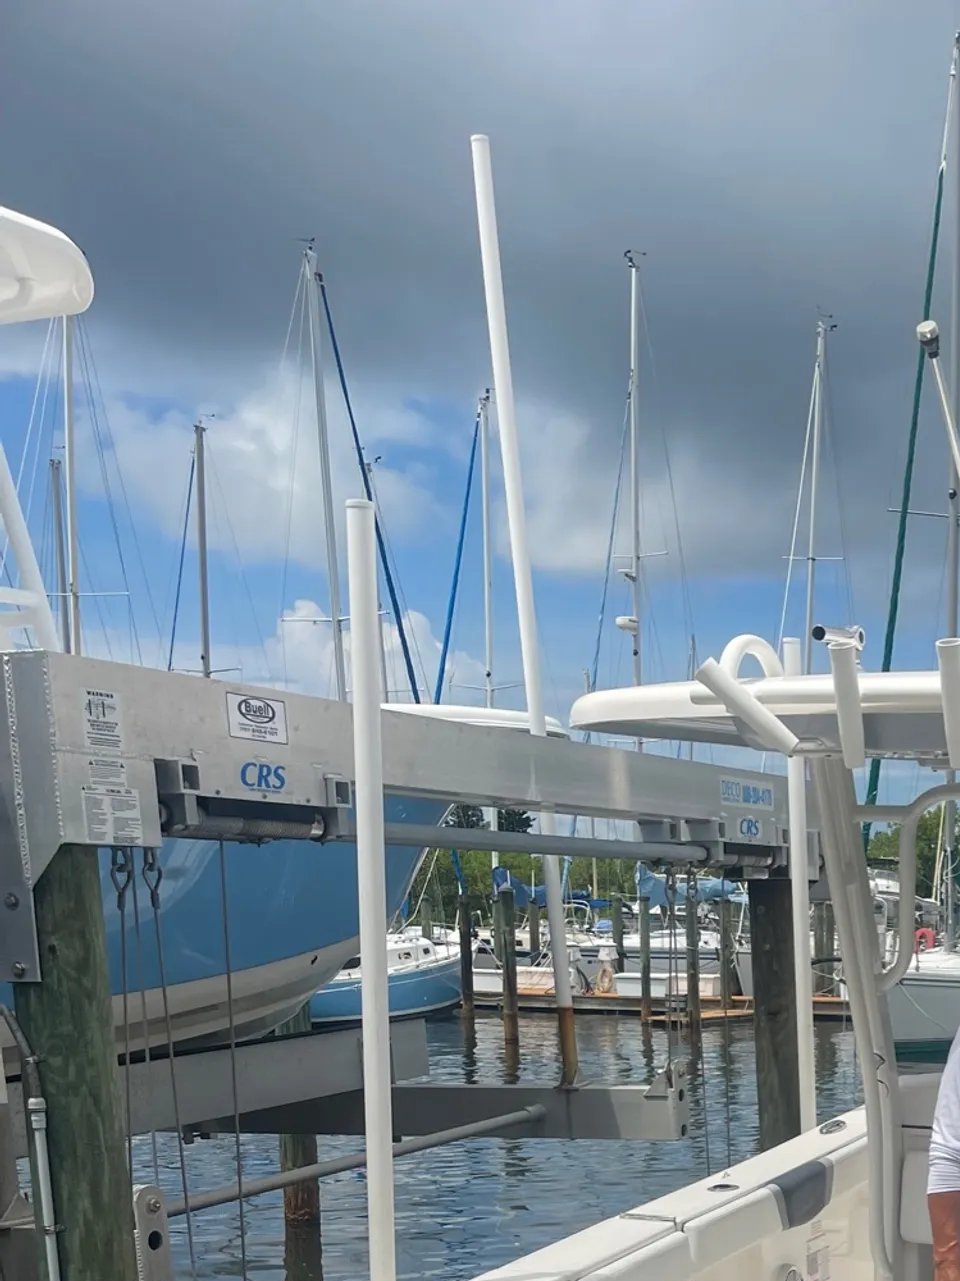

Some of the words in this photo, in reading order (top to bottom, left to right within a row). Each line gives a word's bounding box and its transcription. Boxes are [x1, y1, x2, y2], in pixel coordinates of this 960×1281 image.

[244, 701, 270, 716] Buell
[240, 762, 286, 790] CRS
[740, 818, 760, 836] CRS
